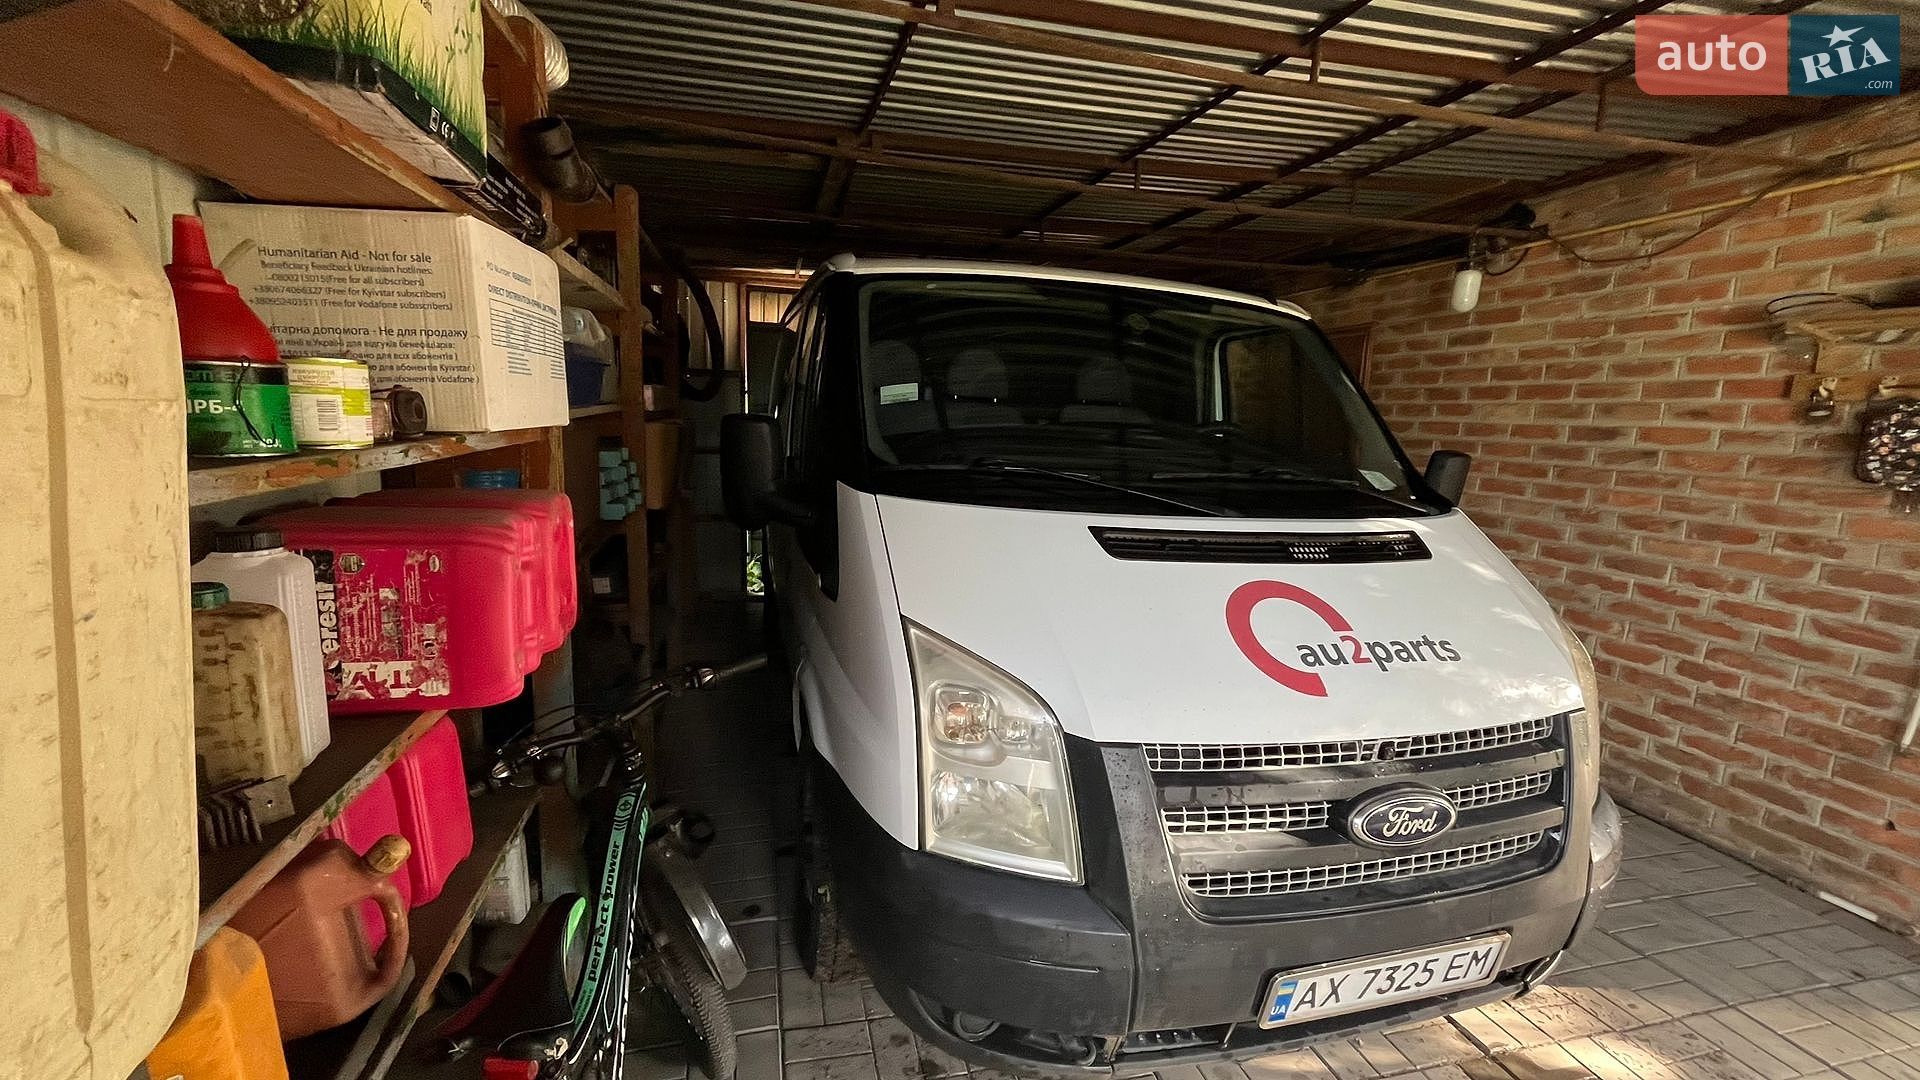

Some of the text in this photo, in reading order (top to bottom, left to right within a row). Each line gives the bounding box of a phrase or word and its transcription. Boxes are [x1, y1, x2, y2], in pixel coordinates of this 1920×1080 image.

[257, 246, 337, 259] Humanitarian
[341, 250, 359, 259] Aid
[368, 250, 389, 261] Not
[392, 250, 408, 261] for
[410, 252, 432, 263] sale
[354, 263, 395, 273] Ukrainian
[375, 278, 425, 287] subscribers)
[348, 287, 361, 296] for
[362, 288, 395, 298] Kyivstar
[396, 289, 446, 299] subscribers)
[344, 298, 356, 308] for
[358, 300, 398, 309] Vodafone
[312, 326, 370, 336] допомога
[379, 326, 394, 336] Не
[396, 328, 417, 338] для
[419, 329, 468, 340] продажу
[436, 375, 475, 384] Vodafone
[315, 581, 341, 658] eresit
[1296, 634, 1462, 672] au2parts
[1382, 804, 1438, 838] Ford
[602, 840, 621, 899] power
[1292, 946, 1493, 1012] AX 7325 EM
[1271, 1004, 1287, 1016] UA
